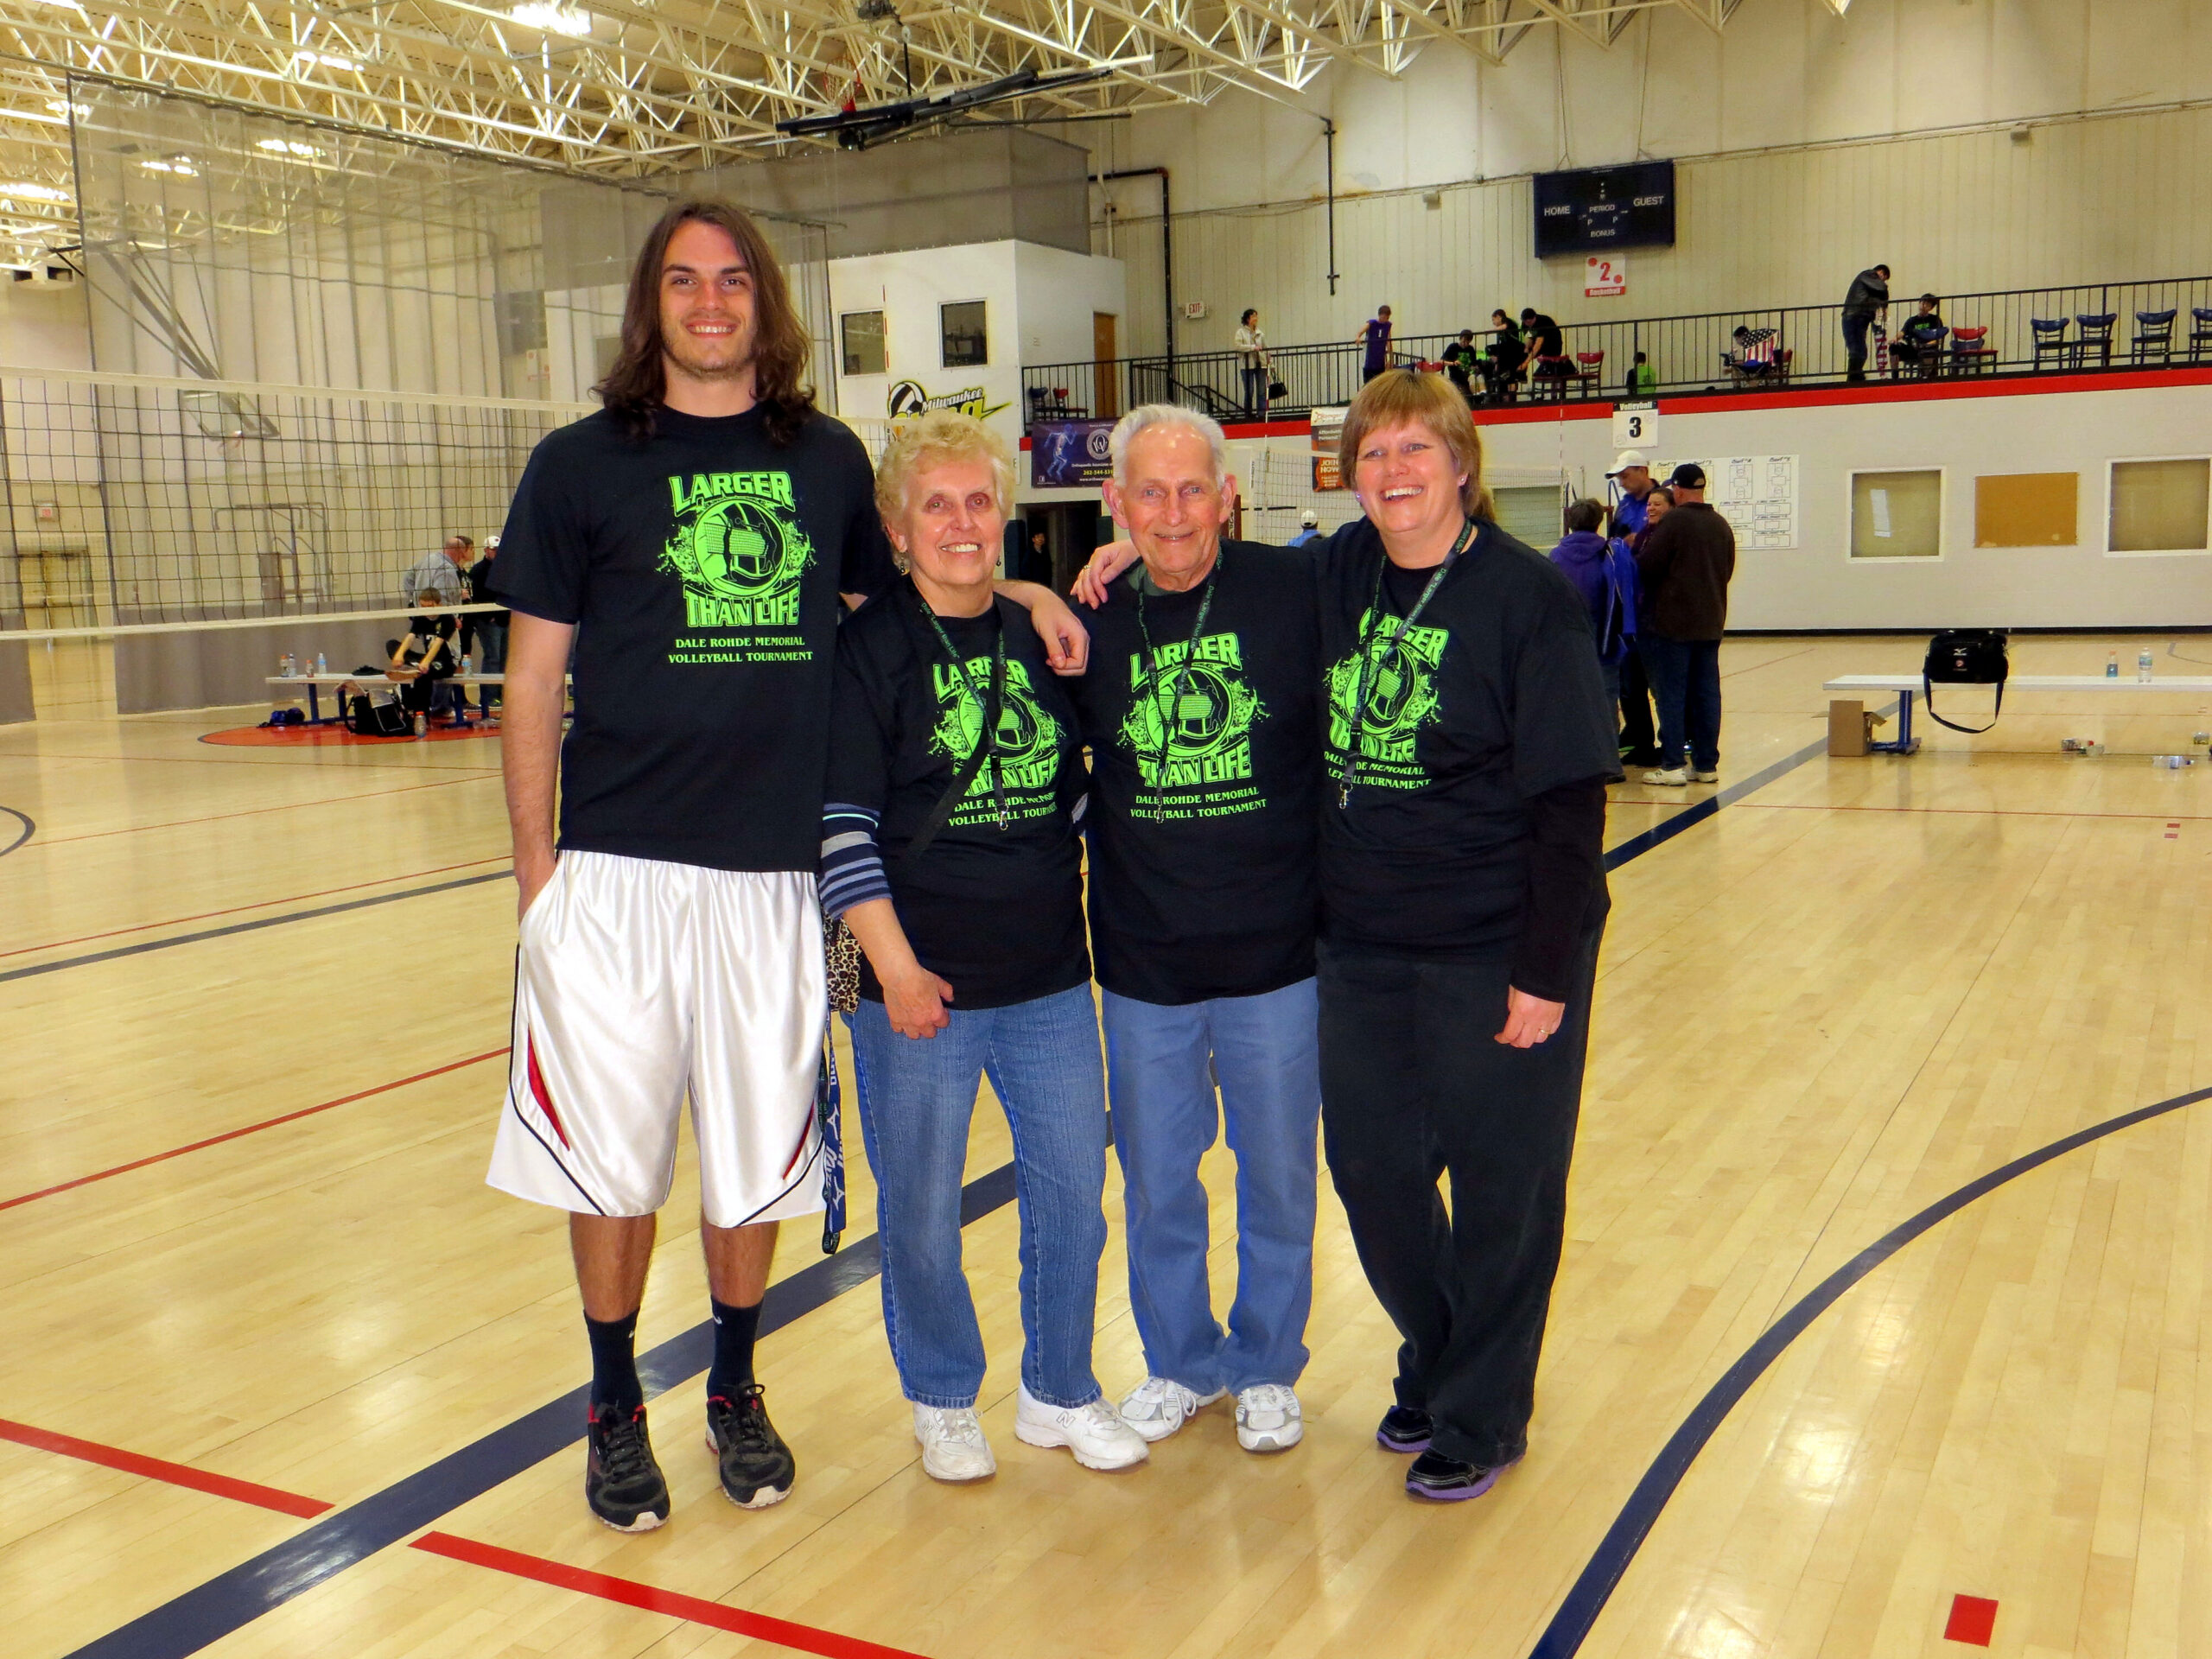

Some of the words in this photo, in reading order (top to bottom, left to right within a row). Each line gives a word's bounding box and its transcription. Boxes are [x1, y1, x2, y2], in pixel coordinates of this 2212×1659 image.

[1589, 204, 1615, 213] PERIOD
[1633, 195, 1664, 207] GUEST
[1543, 206, 1571, 216] HOME
[1590, 228, 1616, 238] BONUS
[1599, 262, 1611, 281] 2
[1189, 302, 1201, 314] EXIT
[921, 388, 983, 413] Milwaukee
[1619, 401, 1653, 411] Volleyball
[1629, 416, 1642, 438] 3
[668, 471, 797, 518] LARGER
[1433, 566, 1446, 582] Dale
[683, 584, 753, 627] THAN
[754, 581, 802, 627] LIFE
[1409, 602, 1422, 618] than
[676, 638, 706, 649] DALE
[709, 638, 752, 649] ROHDE
[755, 636, 805, 647] MEMORIAL
[669, 652, 743, 664] VOLLEYBALL
[746, 651, 814, 662] TOURNAMENT
[1202, 735, 1252, 784] LIFE
[1370, 763, 1426, 776] MEMORIAL
[1362, 776, 1432, 790] TOURNAMENT
[954, 799, 984, 813] DALE
[988, 794, 1027, 808] RHDE
[1162, 794, 1202, 805] ROHDE
[1205, 786, 1259, 803] MEMORIAL
[1197, 799, 1267, 818] TOURNAMENT
